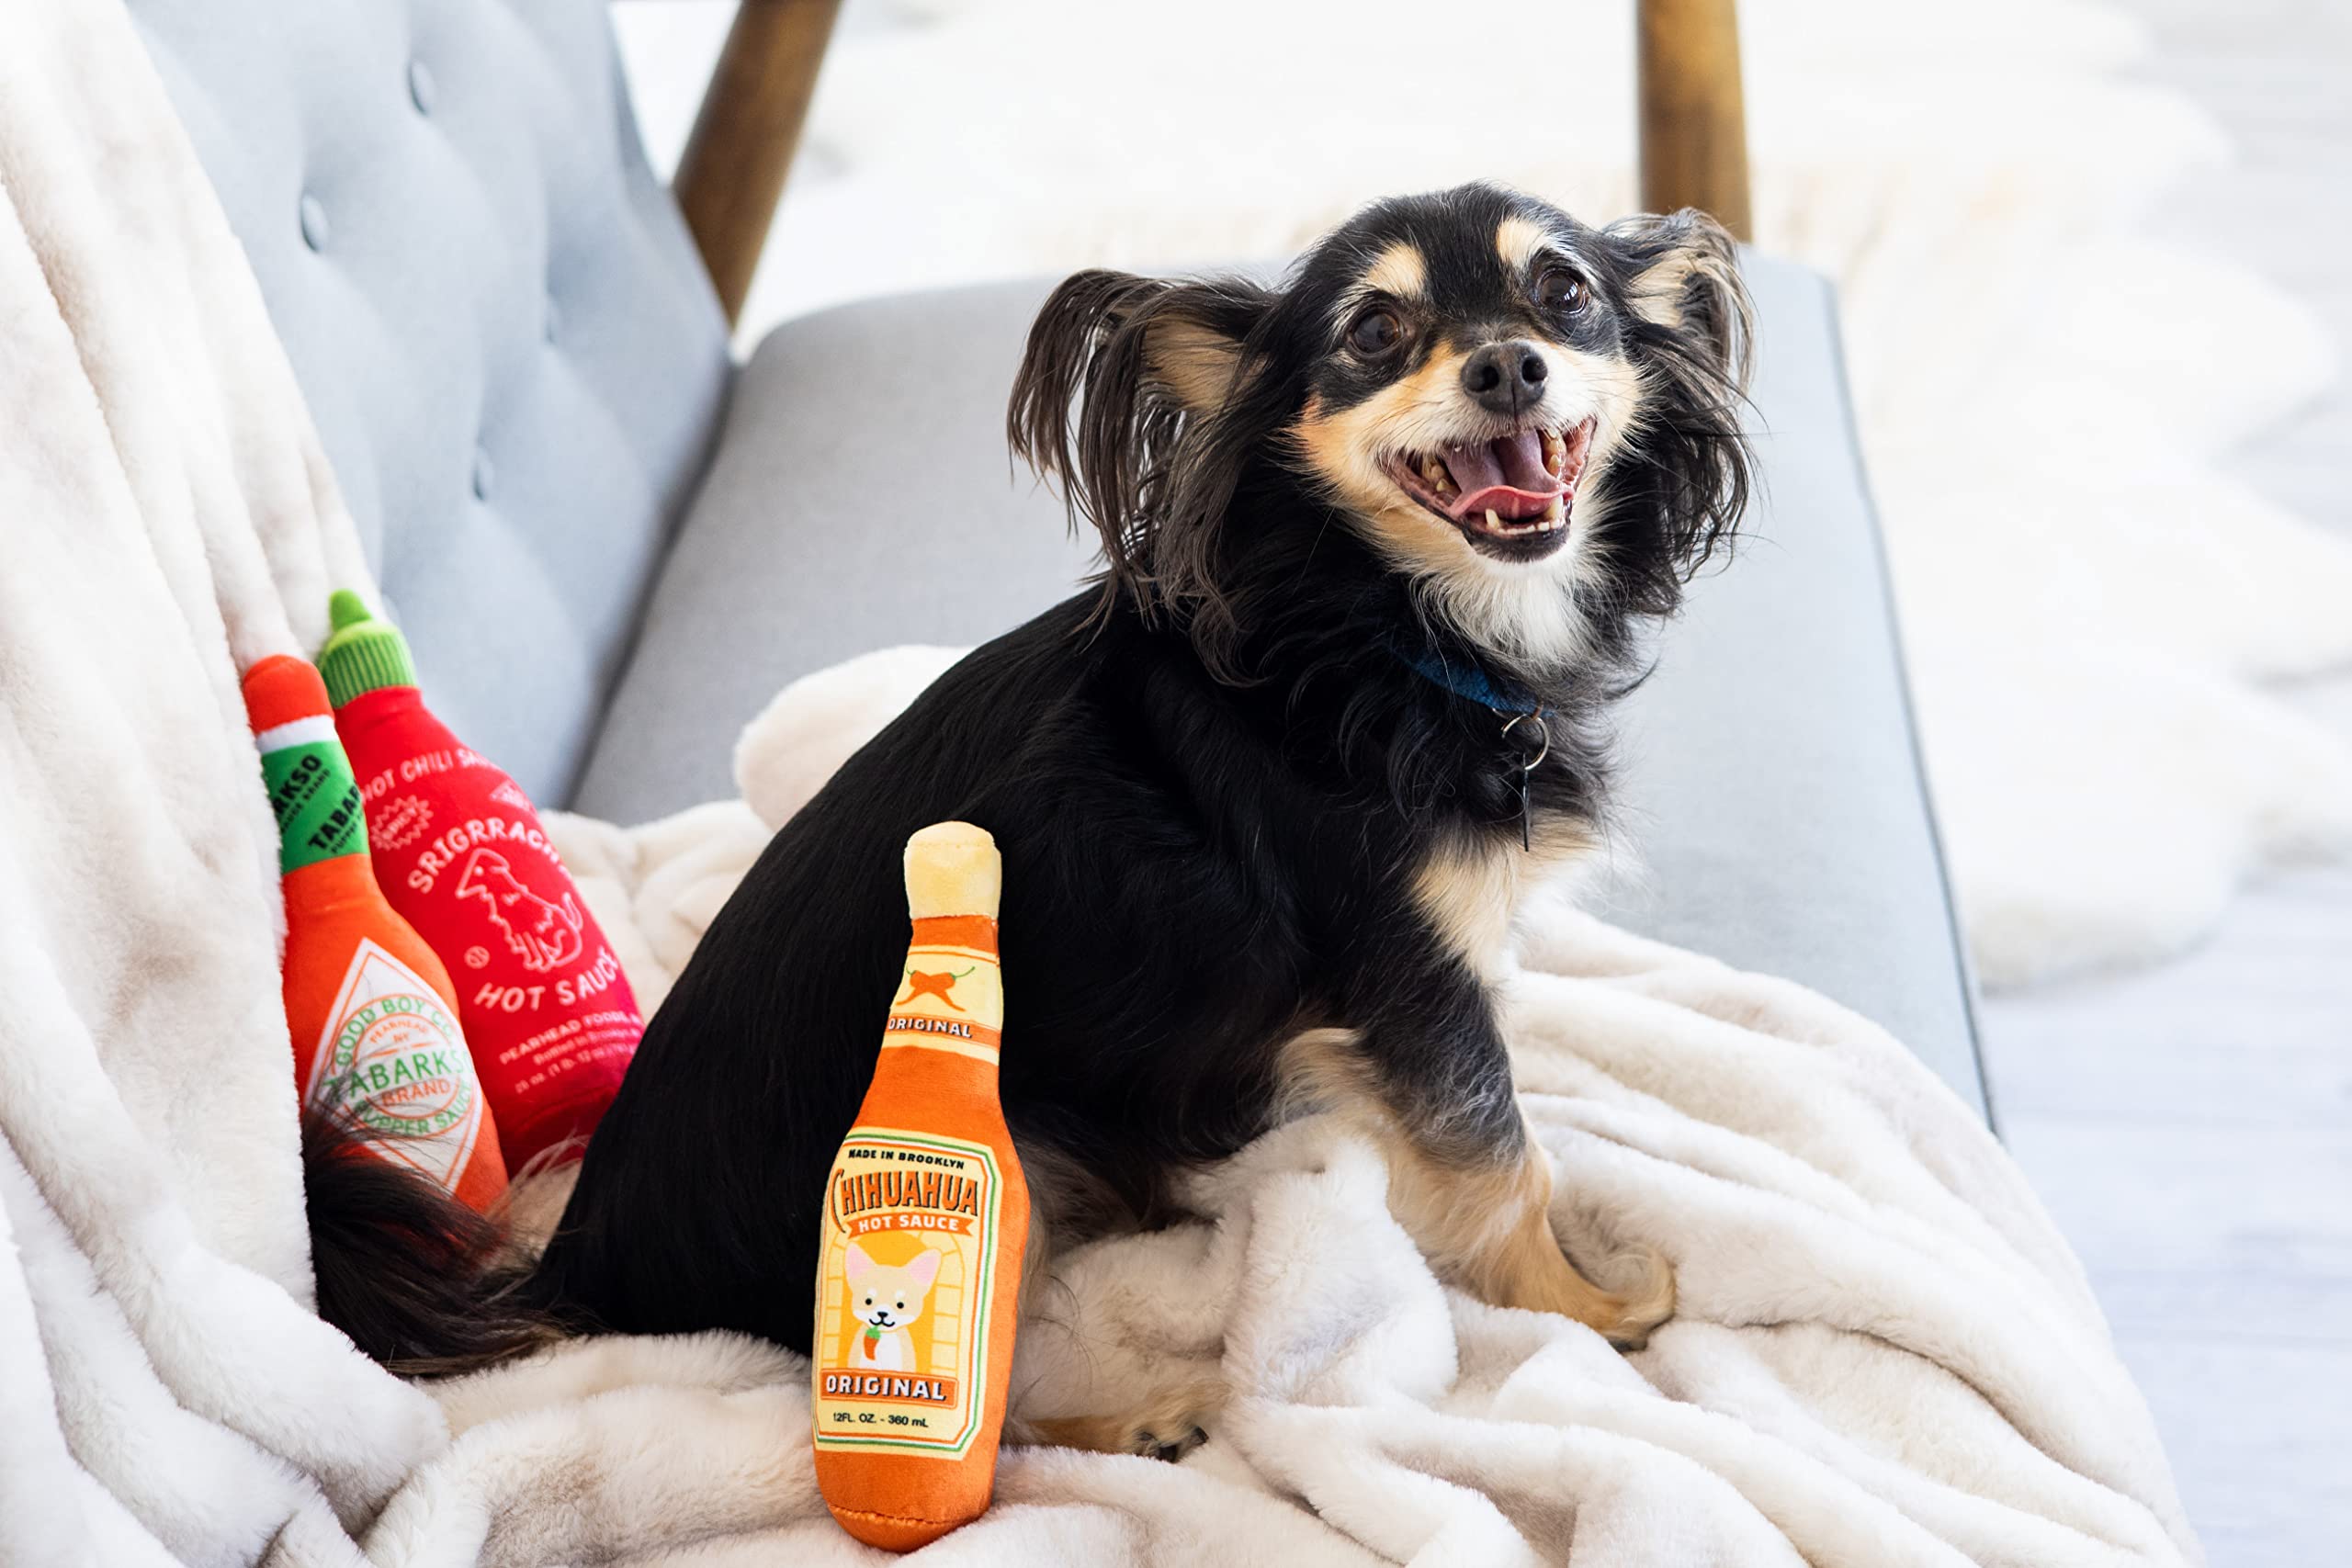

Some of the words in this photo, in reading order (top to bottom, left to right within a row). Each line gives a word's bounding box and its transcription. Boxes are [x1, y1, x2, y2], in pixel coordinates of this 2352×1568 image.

[400, 750, 454, 783] CHILI
[407, 817, 571, 894] SRIGRRAC
[473, 982, 547, 1013] HOT
[334, 1008, 377, 1066] GOOD
[381, 997, 425, 1014] BOY
[499, 1019, 582, 1064] PEARHEAD
[888, 1017, 974, 1039] ORIGINAL
[380, 1078, 451, 1107] BRAND
[848, 1148, 876, 1159] MADE
[880, 1150, 894, 1160] IN
[899, 1152, 965, 1169] BROOKLYN
[830, 1168, 978, 1233] CHIHUAHUA
[858, 1215, 892, 1234] HOT
[899, 1214, 959, 1232] SAUCE
[825, 1374, 947, 1401] ORIGINAL
[888, 1415, 909, 1426] 360
[911, 1417, 929, 1428] mL
